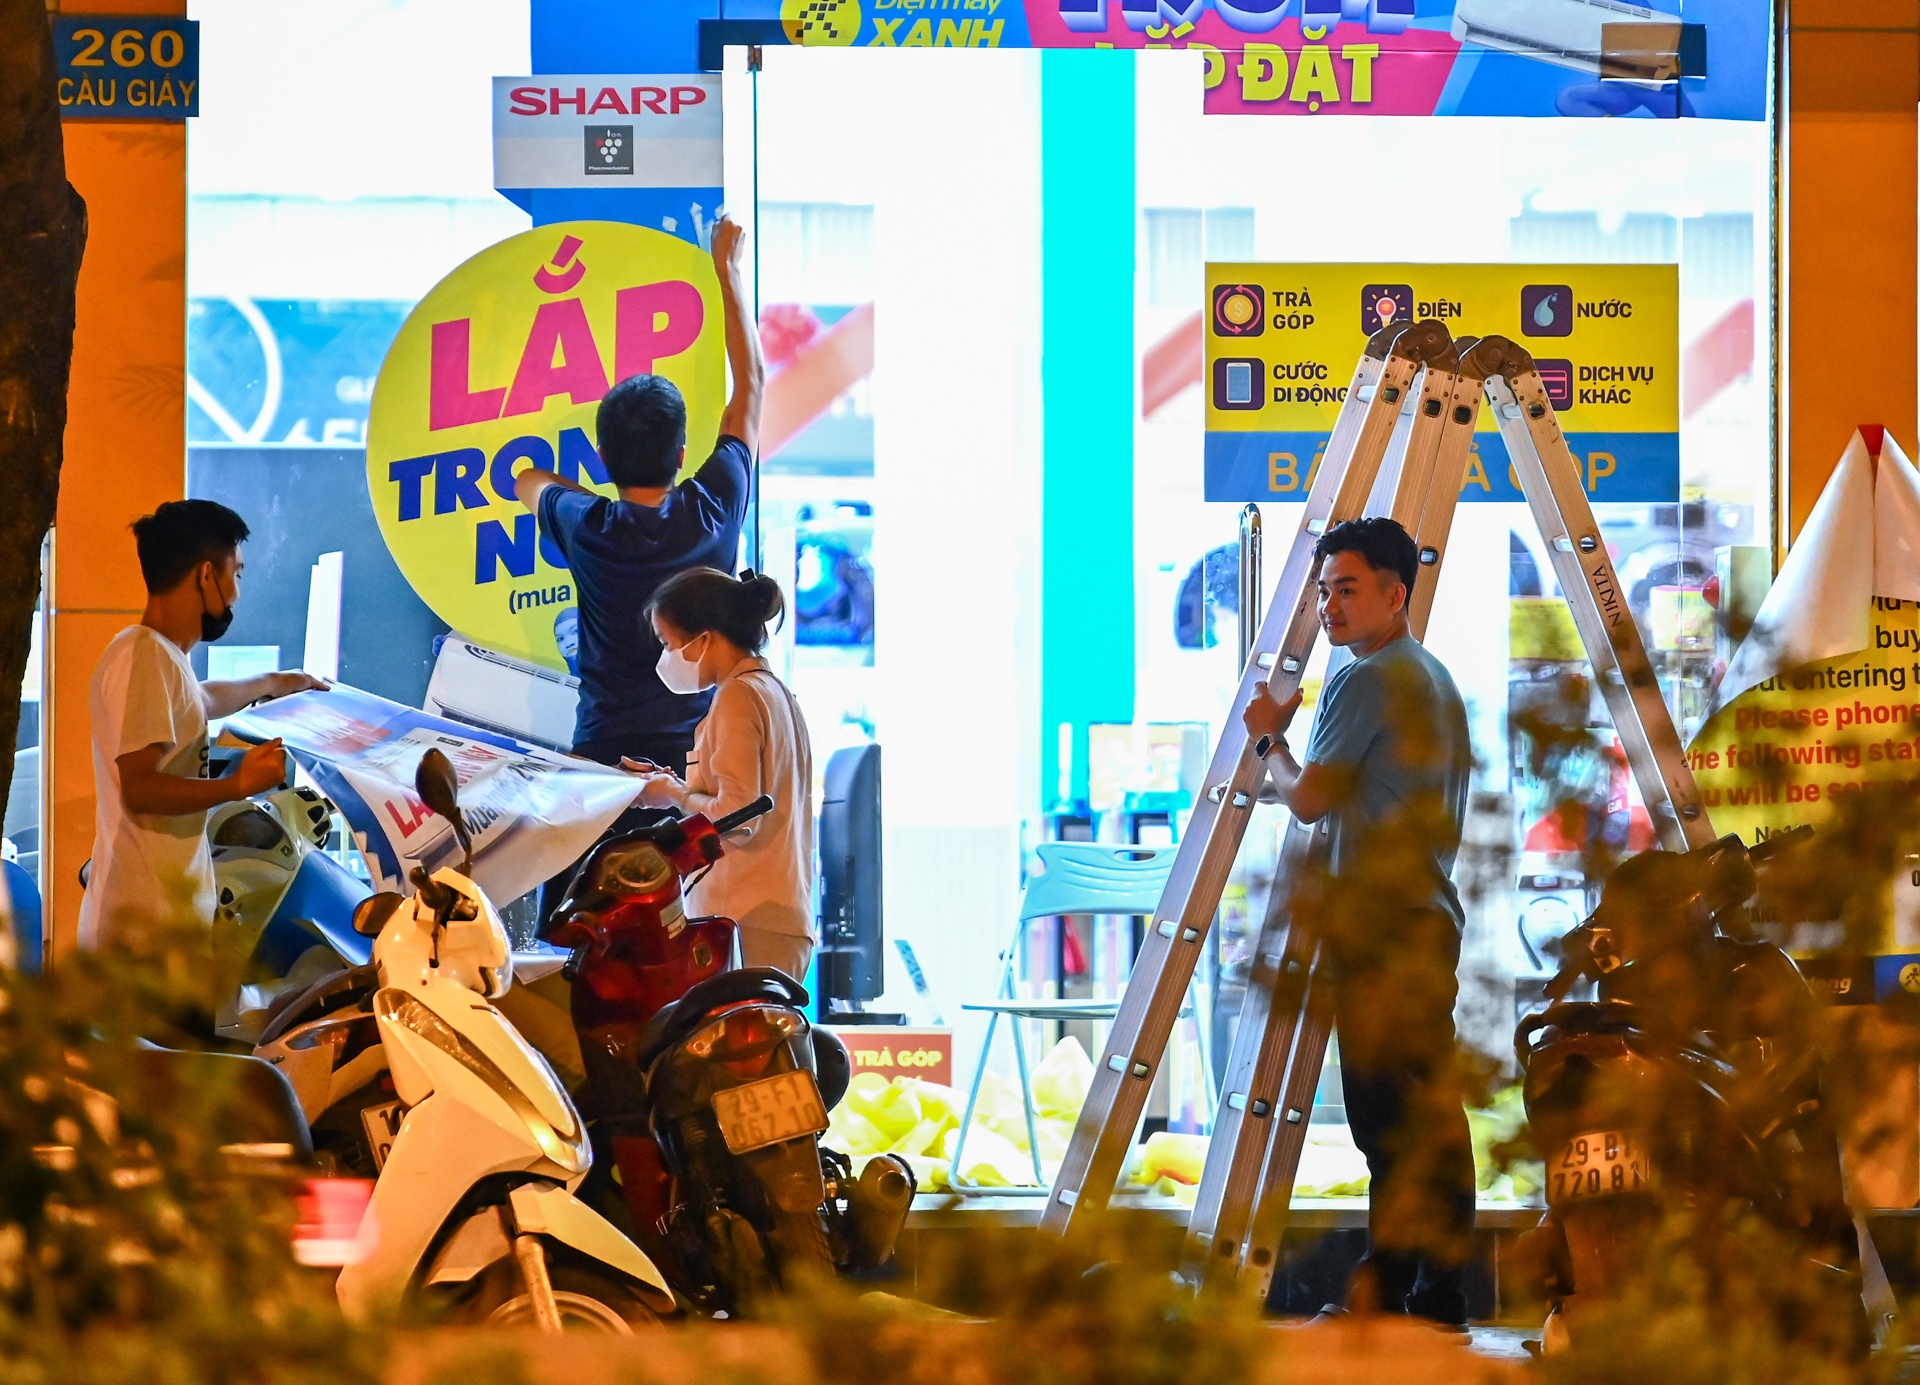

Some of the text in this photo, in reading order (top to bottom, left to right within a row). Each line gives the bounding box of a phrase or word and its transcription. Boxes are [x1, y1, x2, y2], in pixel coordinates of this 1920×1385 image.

[866, 17, 1005, 48] XANH
[70, 28, 184, 68] 260
[1237, 25, 1379, 112] ĐẶT
[57, 71, 117, 106] CẦU
[509, 86, 707, 116] SHARP
[1272, 286, 1313, 307] TRẢ
[1417, 298, 1462, 320] ĐIỆN
[1576, 299, 1633, 320] NƯỚC
[429, 233, 705, 432] LẮP
[1272, 310, 1315, 331] GÓP
[1272, 361, 1328, 382] CƯỚC
[1579, 365, 1654, 386] DỊCH VỤ
[1273, 384, 1349, 407] DI ĐỘNG
[1579, 388, 1632, 406] KHÁC
[1592, 564, 1624, 627] NIKITA
[1734, 701, 1920, 732] Please phone
[1725, 739, 1862, 769] following
[1727, 780, 1779, 806] will
[1786, 782, 1821, 804] be
[854, 1046, 943, 1068] TRẢ GÓP
